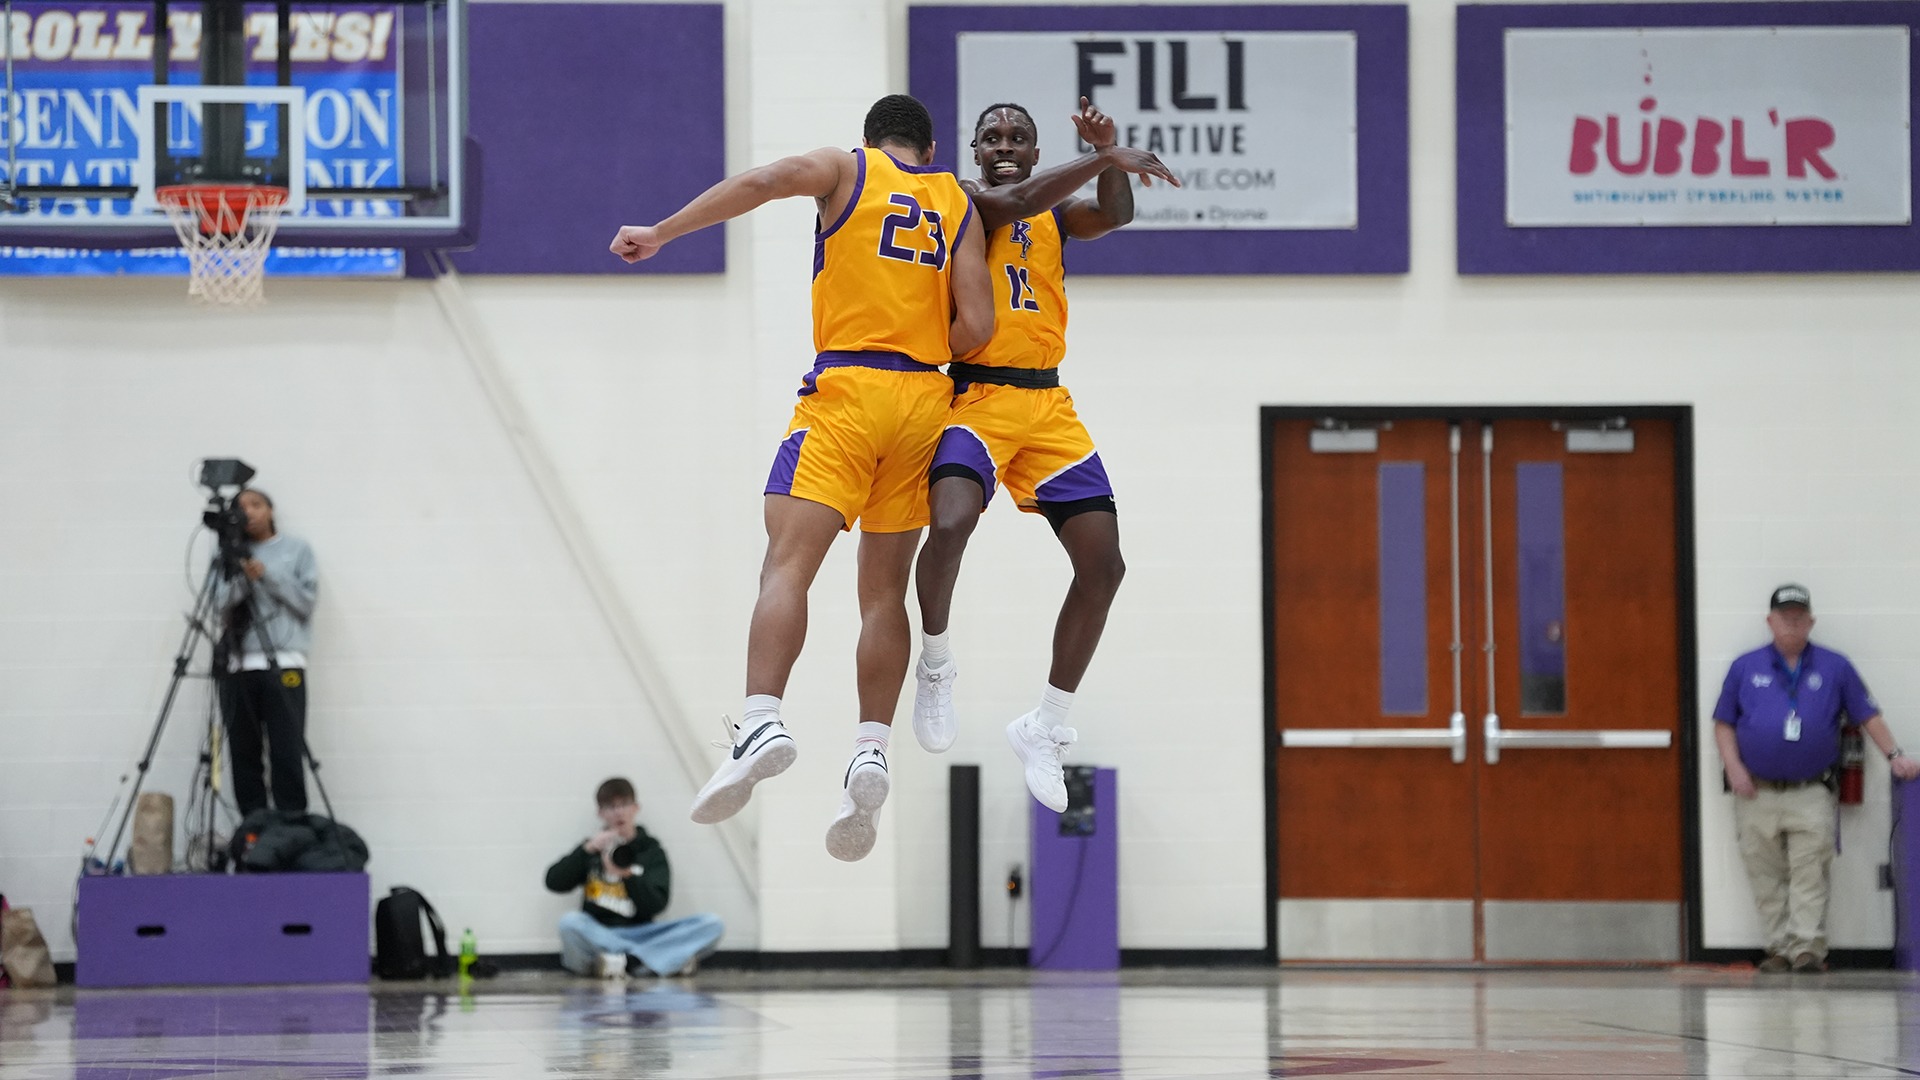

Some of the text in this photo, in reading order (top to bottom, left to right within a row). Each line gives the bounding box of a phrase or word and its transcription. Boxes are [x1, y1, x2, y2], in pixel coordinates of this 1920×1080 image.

[167, 11, 393, 61] YTES!
[1074, 40, 1249, 111] FILI
[1569, 98, 1839, 180] BUBBL'R
[878, 193, 947, 272] 23
